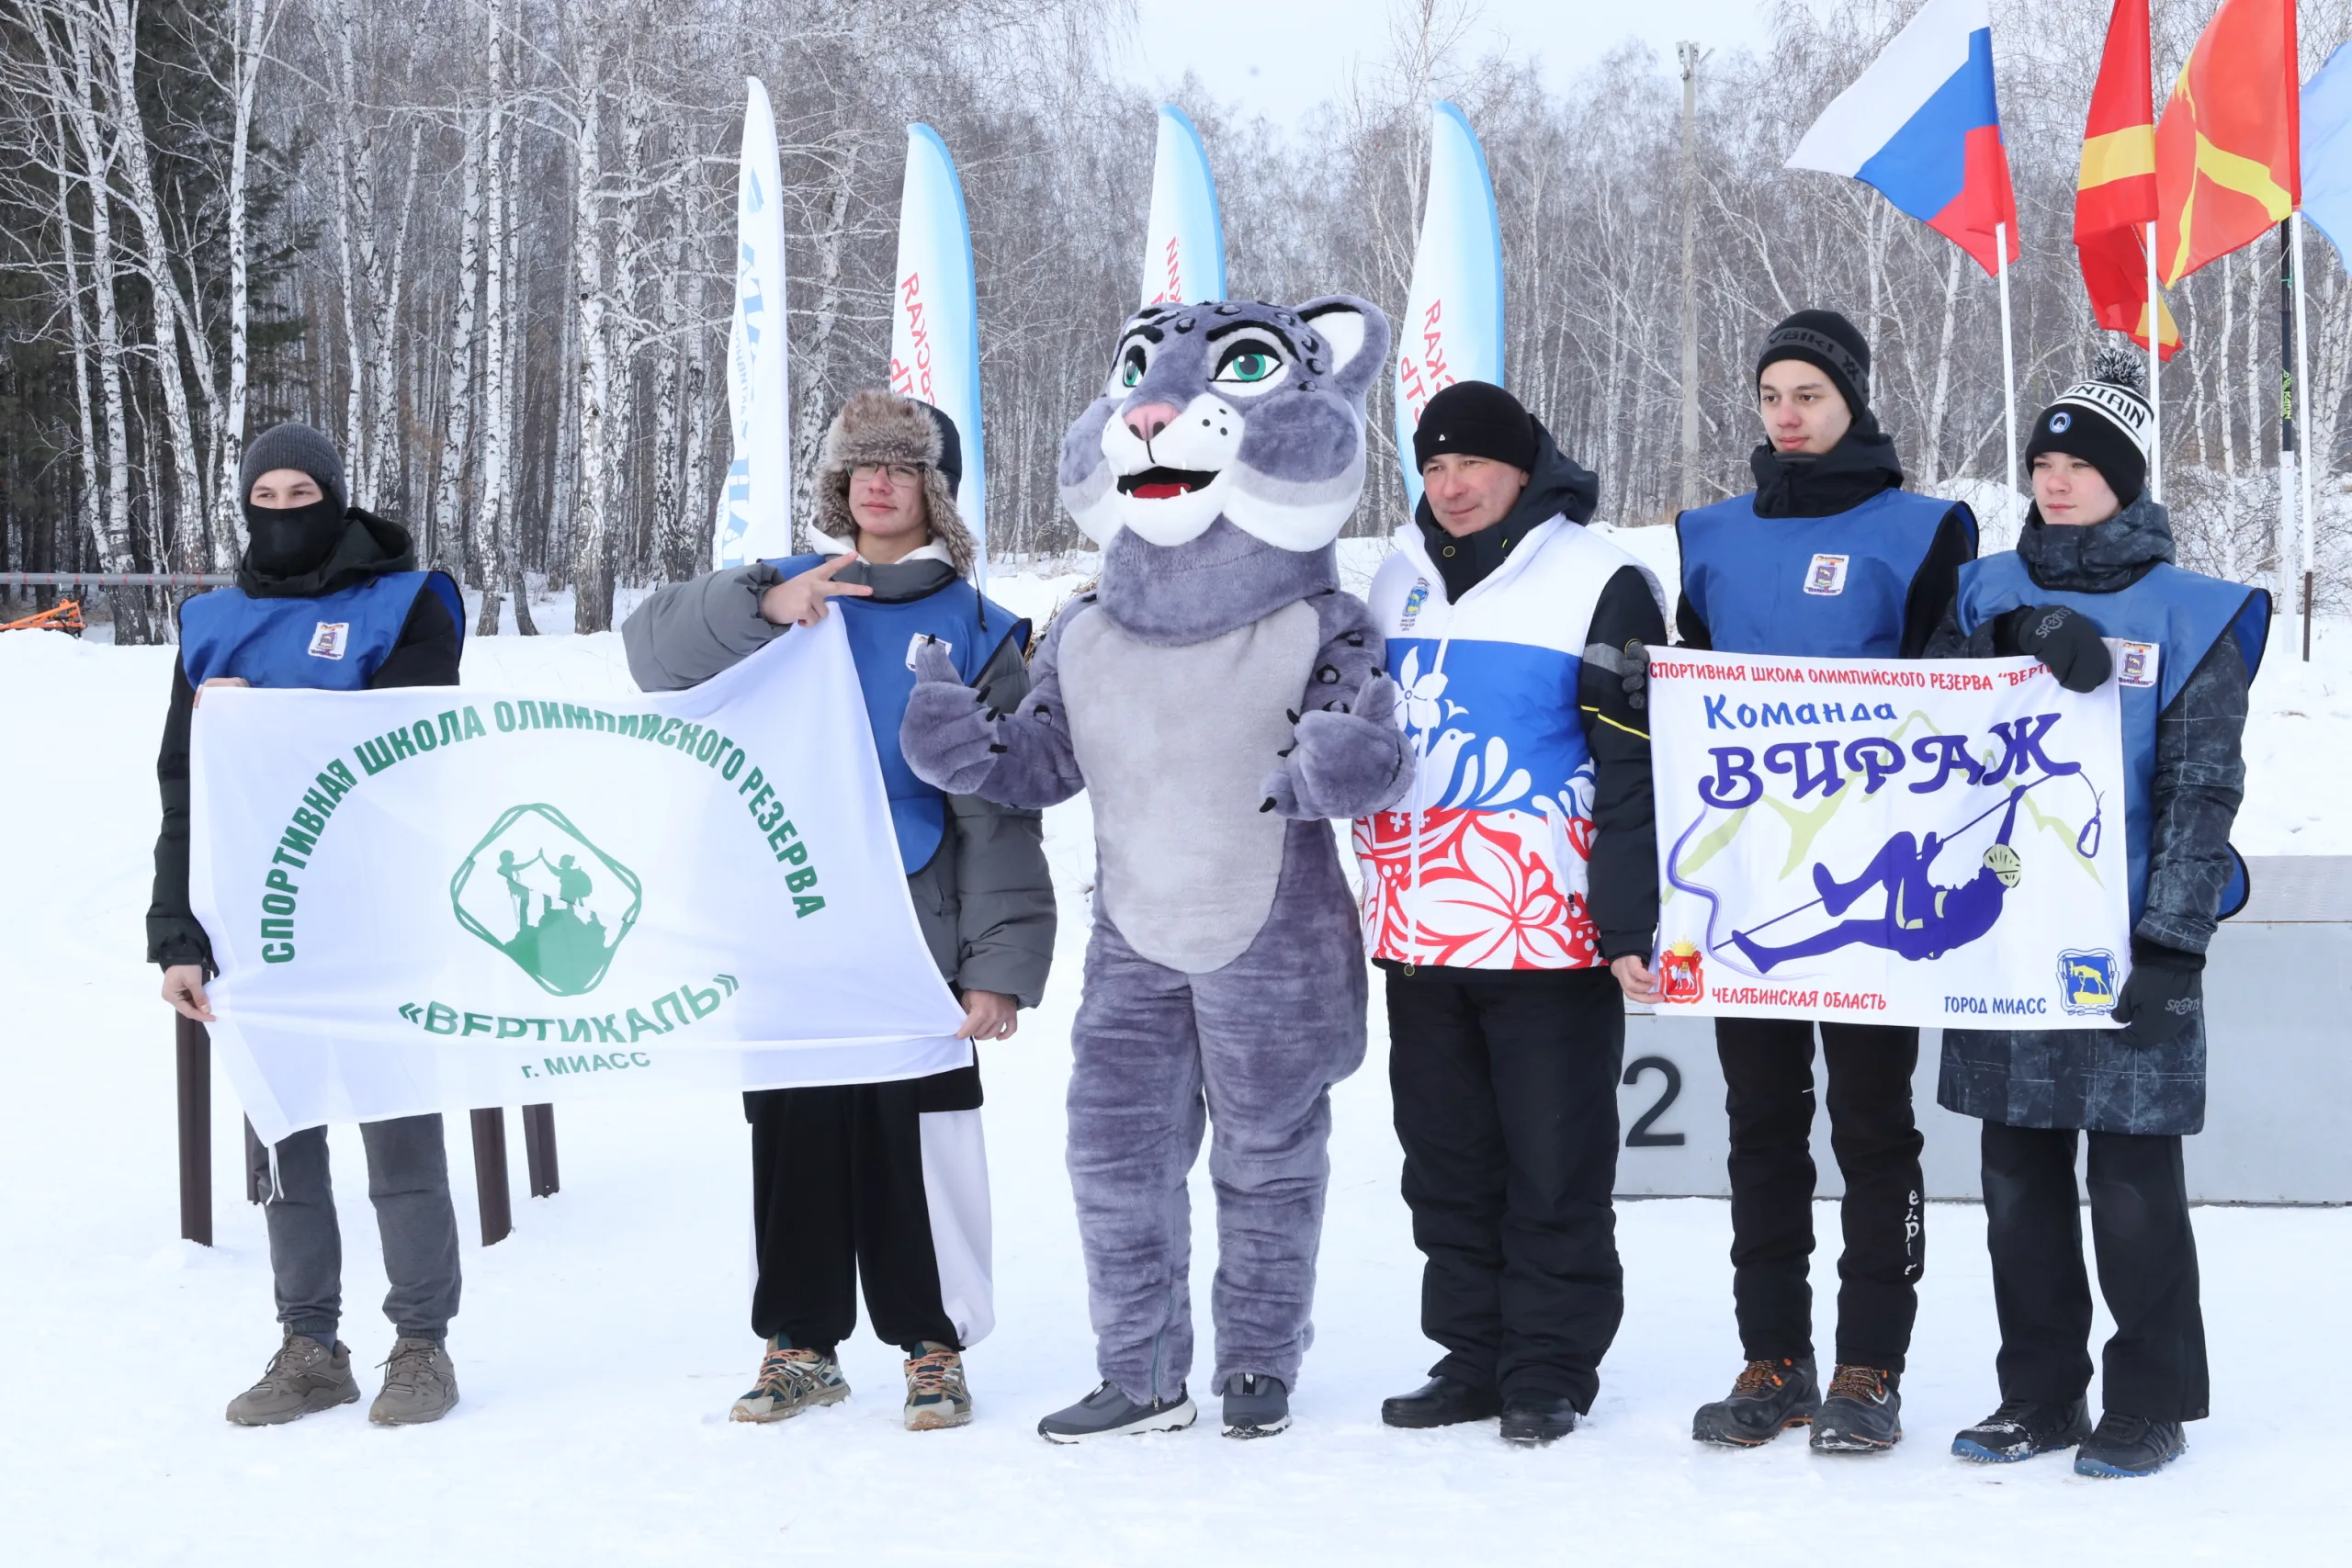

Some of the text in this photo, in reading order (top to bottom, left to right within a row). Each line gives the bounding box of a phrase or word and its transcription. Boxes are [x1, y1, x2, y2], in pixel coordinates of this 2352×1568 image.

[1650, 661, 1747, 682] СПОРТИВНАЯ
[1750, 666, 1805, 683] ШКОЛА
[1808, 668, 1926, 688] ОЛИМПИЙСКОГО
[1930, 672, 1994, 691] РЕЗЕРВА
[1703, 694, 1898, 729] Команда
[1698, 713, 2082, 809] ВИРАЖ
[261, 700, 826, 964] СПОРТИВНАЯ ШКОЛА ОЛИМПИЙСКОГО РЕЗЕРВА
[1712, 987, 1887, 1010] ЧЕЛЯБИНСКАЯ ОБЛАСТЬ
[1944, 996, 2047, 1015] ГОРОД МИАСС
[521, 1052, 651, 1078] г. МИАСС
[1623, 1055, 1685, 1147] 2
